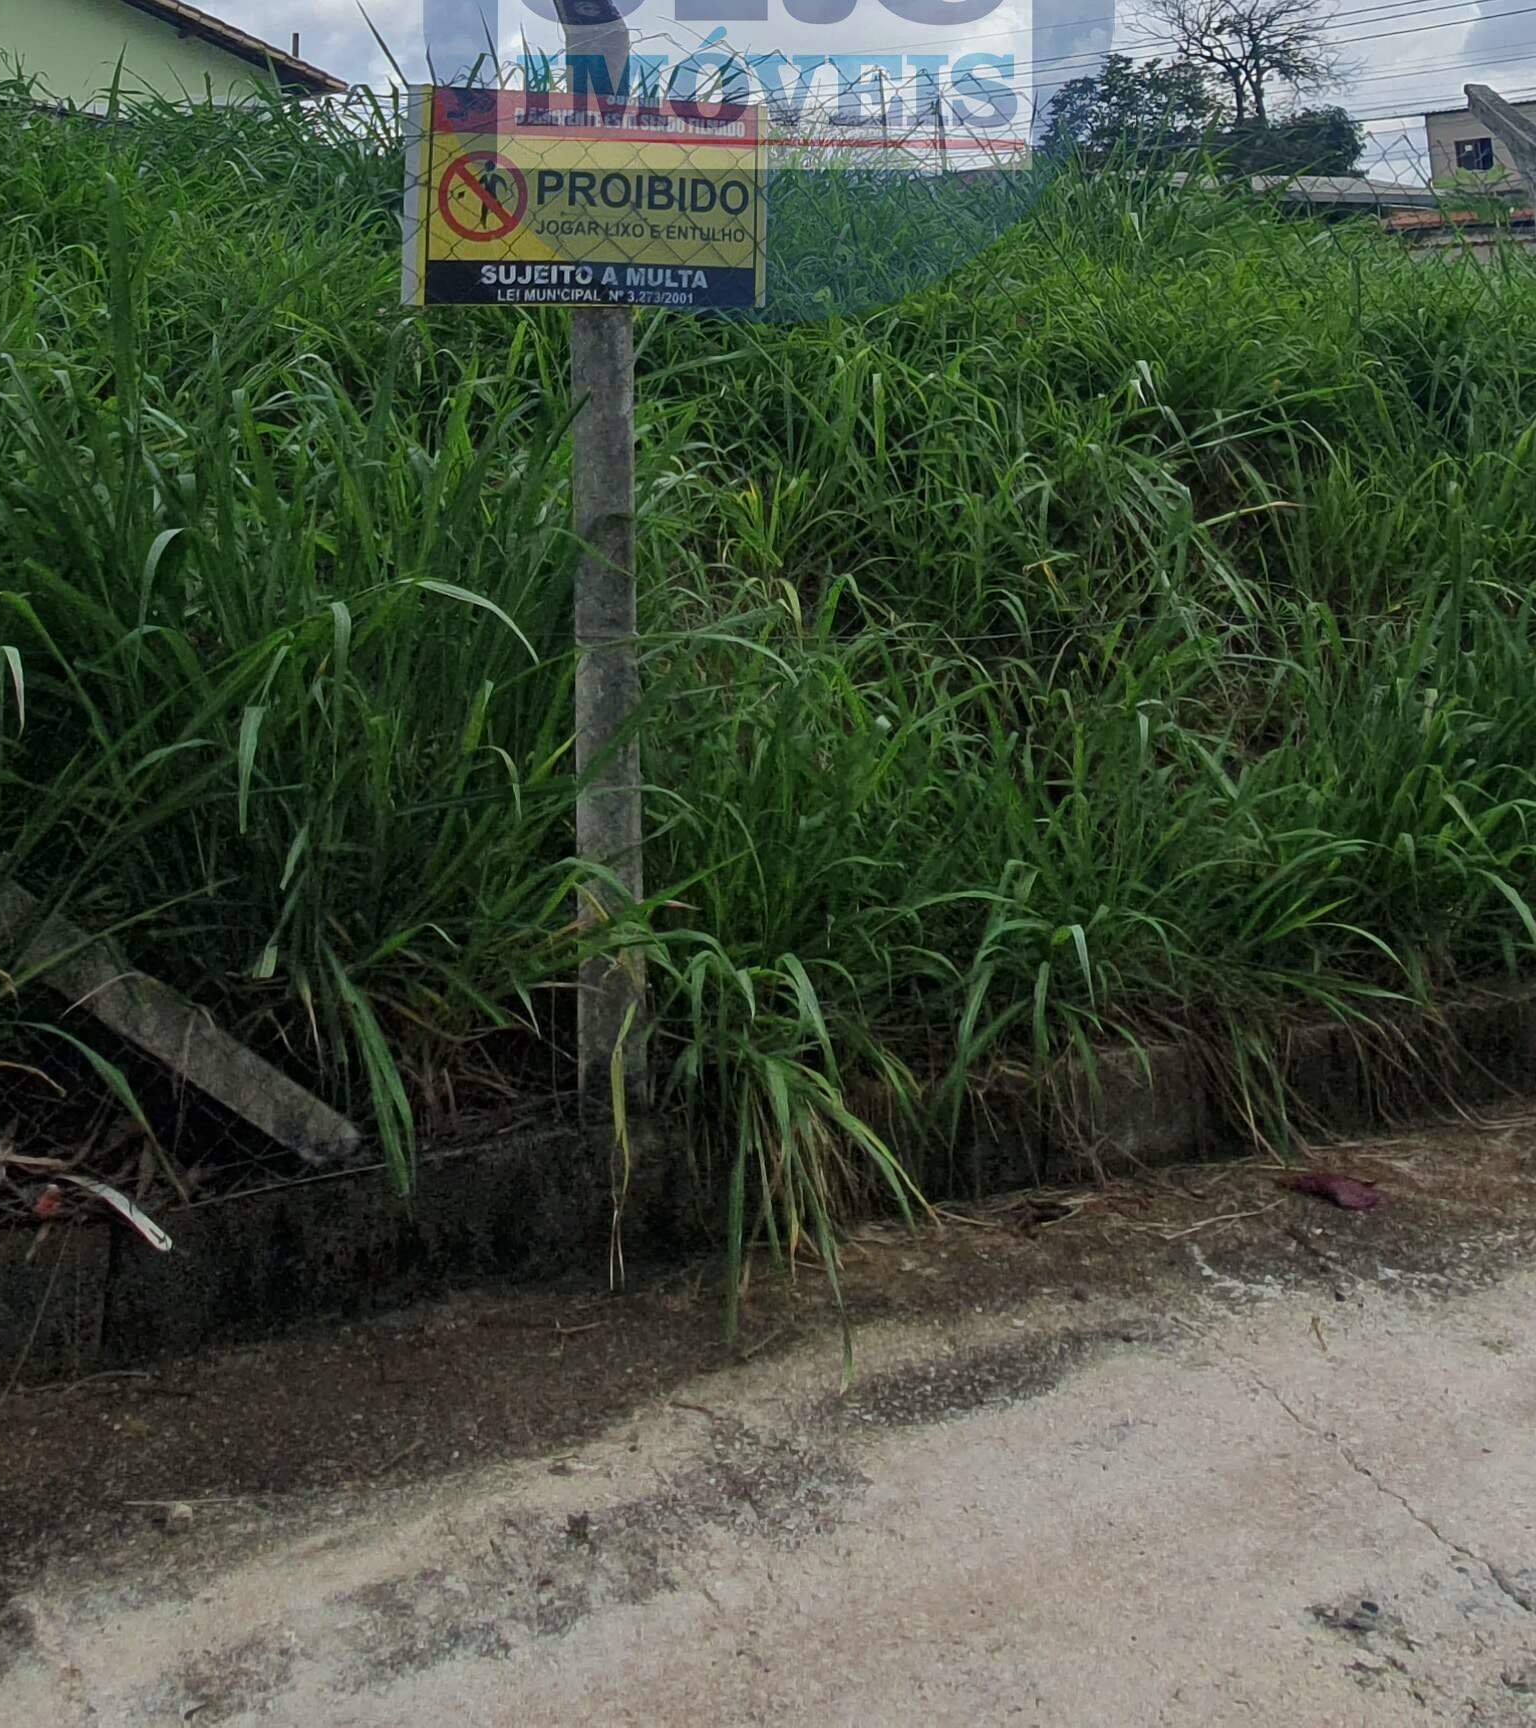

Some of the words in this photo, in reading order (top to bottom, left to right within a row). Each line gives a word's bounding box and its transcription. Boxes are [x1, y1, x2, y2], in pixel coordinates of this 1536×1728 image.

[536, 169, 749, 215] PROIBIDO
[535, 220, 600, 237] JOGAR
[605, 222, 645, 238] LIXO
[650, 224, 661, 239] E
[666, 225, 745, 243] ENTULHO
[480, 265, 593, 285] SUJEITO
[601, 266, 618, 285] A
[626, 267, 708, 288] MULTA
[524, 288, 601, 302] MUNICIPAL
